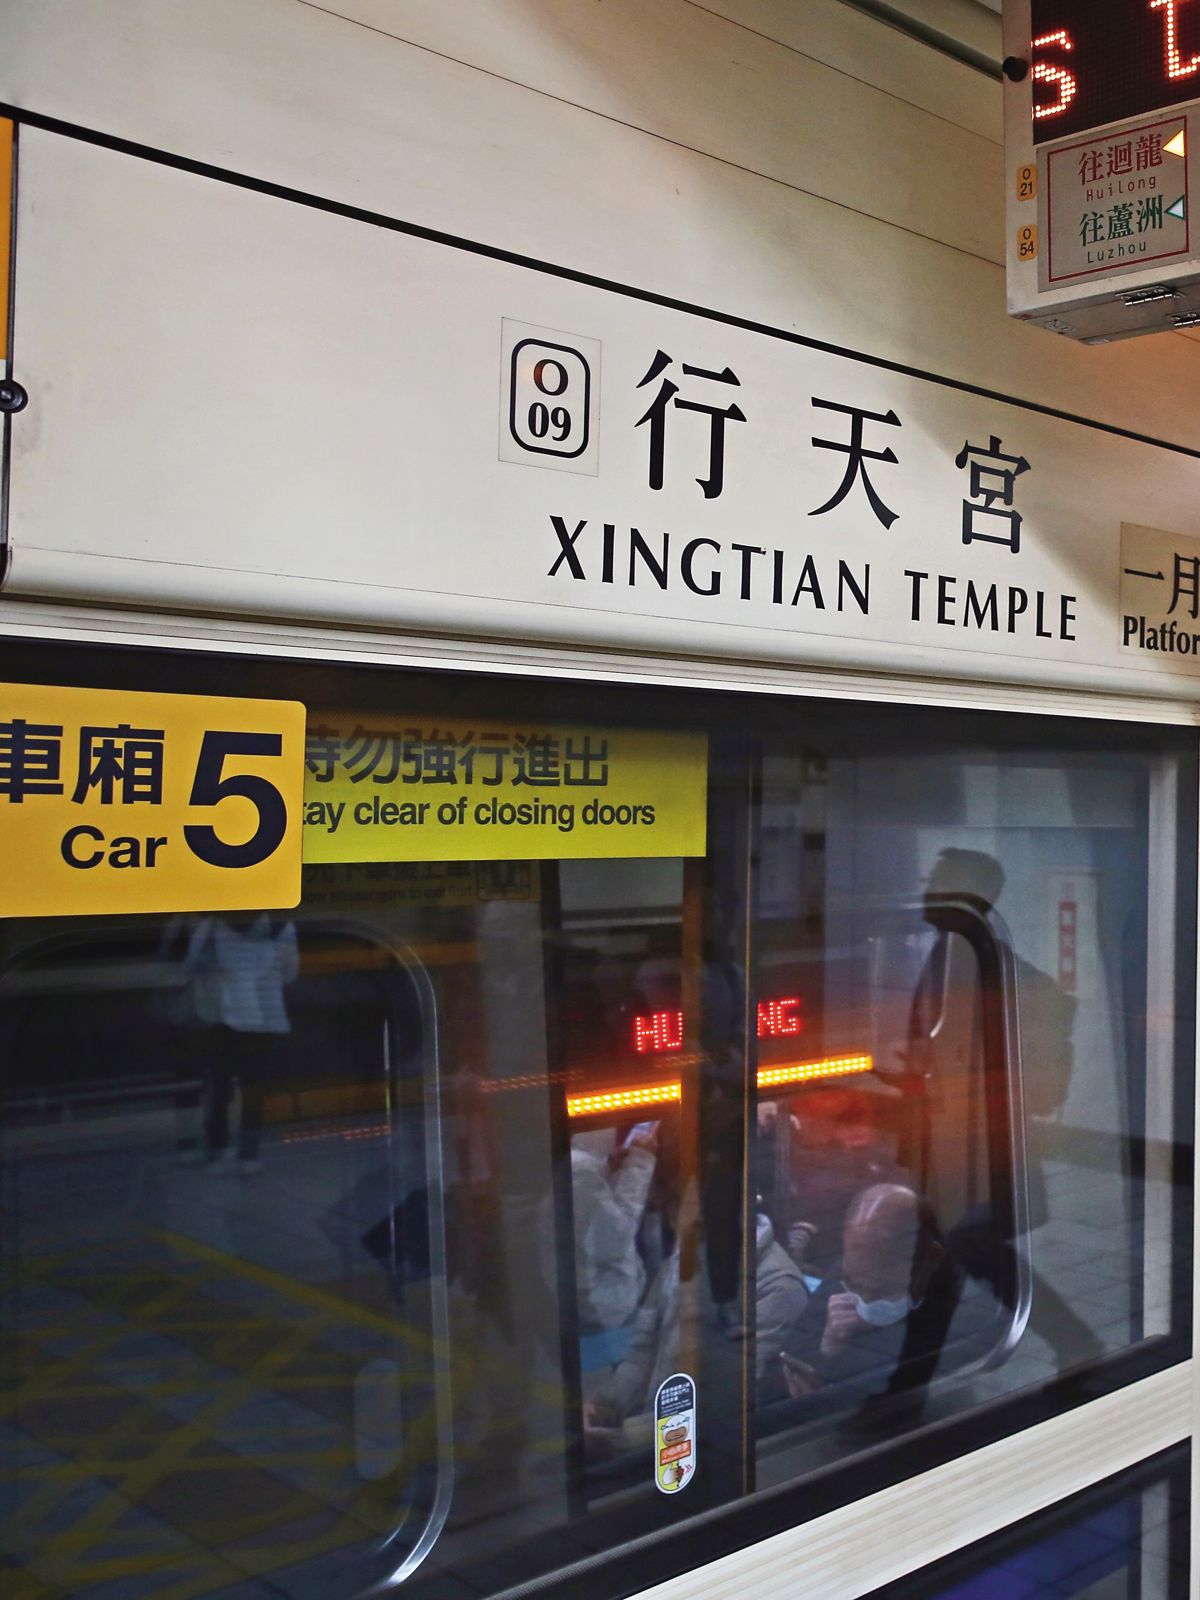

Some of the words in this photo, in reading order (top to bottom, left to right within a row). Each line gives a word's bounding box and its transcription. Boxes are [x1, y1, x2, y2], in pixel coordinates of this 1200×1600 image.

[1078, 135, 1164, 187] 往迴龍
[1019, 181, 1034, 196] 21
[1085, 174, 1158, 203] Huilong
[1079, 193, 1165, 248] 往蘆洲
[1019, 242, 1034, 257] 54
[1086, 240, 1148, 265] Luzhou
[527, 402, 572, 443] 09
[634, 349, 1032, 554] 行天宮
[547, 515, 871, 616] XINGTIAN
[904, 569, 1077, 641] TEMPLE
[0, 719, 165, 805] 車廂
[183, 730, 287, 869] 5
[353, 796, 430, 826] clear
[437, 796, 468, 826] of
[474, 796, 575, 833] closing
[581, 798, 656, 826] doors
[60, 824, 168, 870] Car
